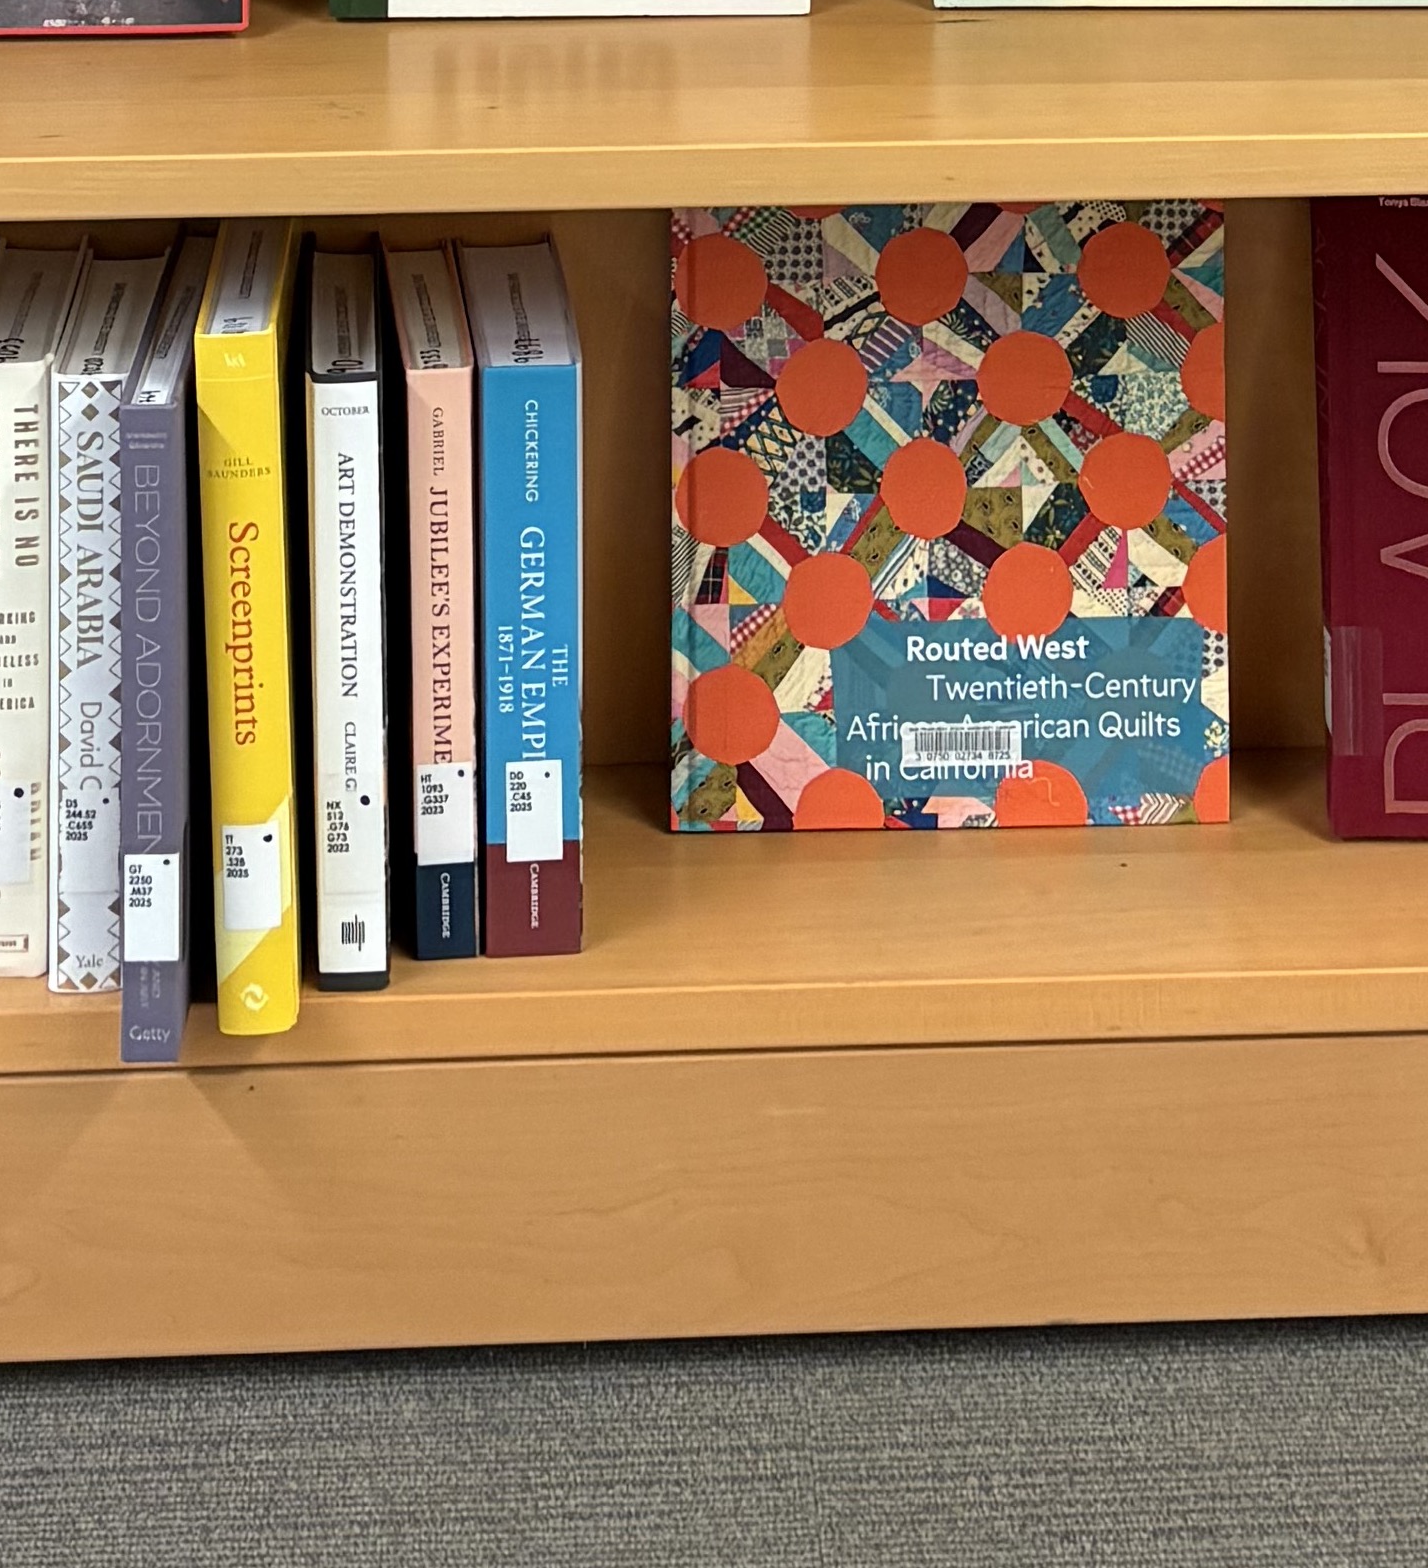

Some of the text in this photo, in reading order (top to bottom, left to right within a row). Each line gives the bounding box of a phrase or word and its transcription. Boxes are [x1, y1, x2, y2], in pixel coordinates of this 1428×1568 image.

[525, 400, 538, 502] CHICKERING
[76, 430, 104, 669] SAUDI ARABIA
[519, 526, 546, 670] GERMAN
[225, 521, 264, 746] Screenprints
[906, 635, 1089, 662] Routed West
[926, 674, 1197, 703] Twentieth-Century
